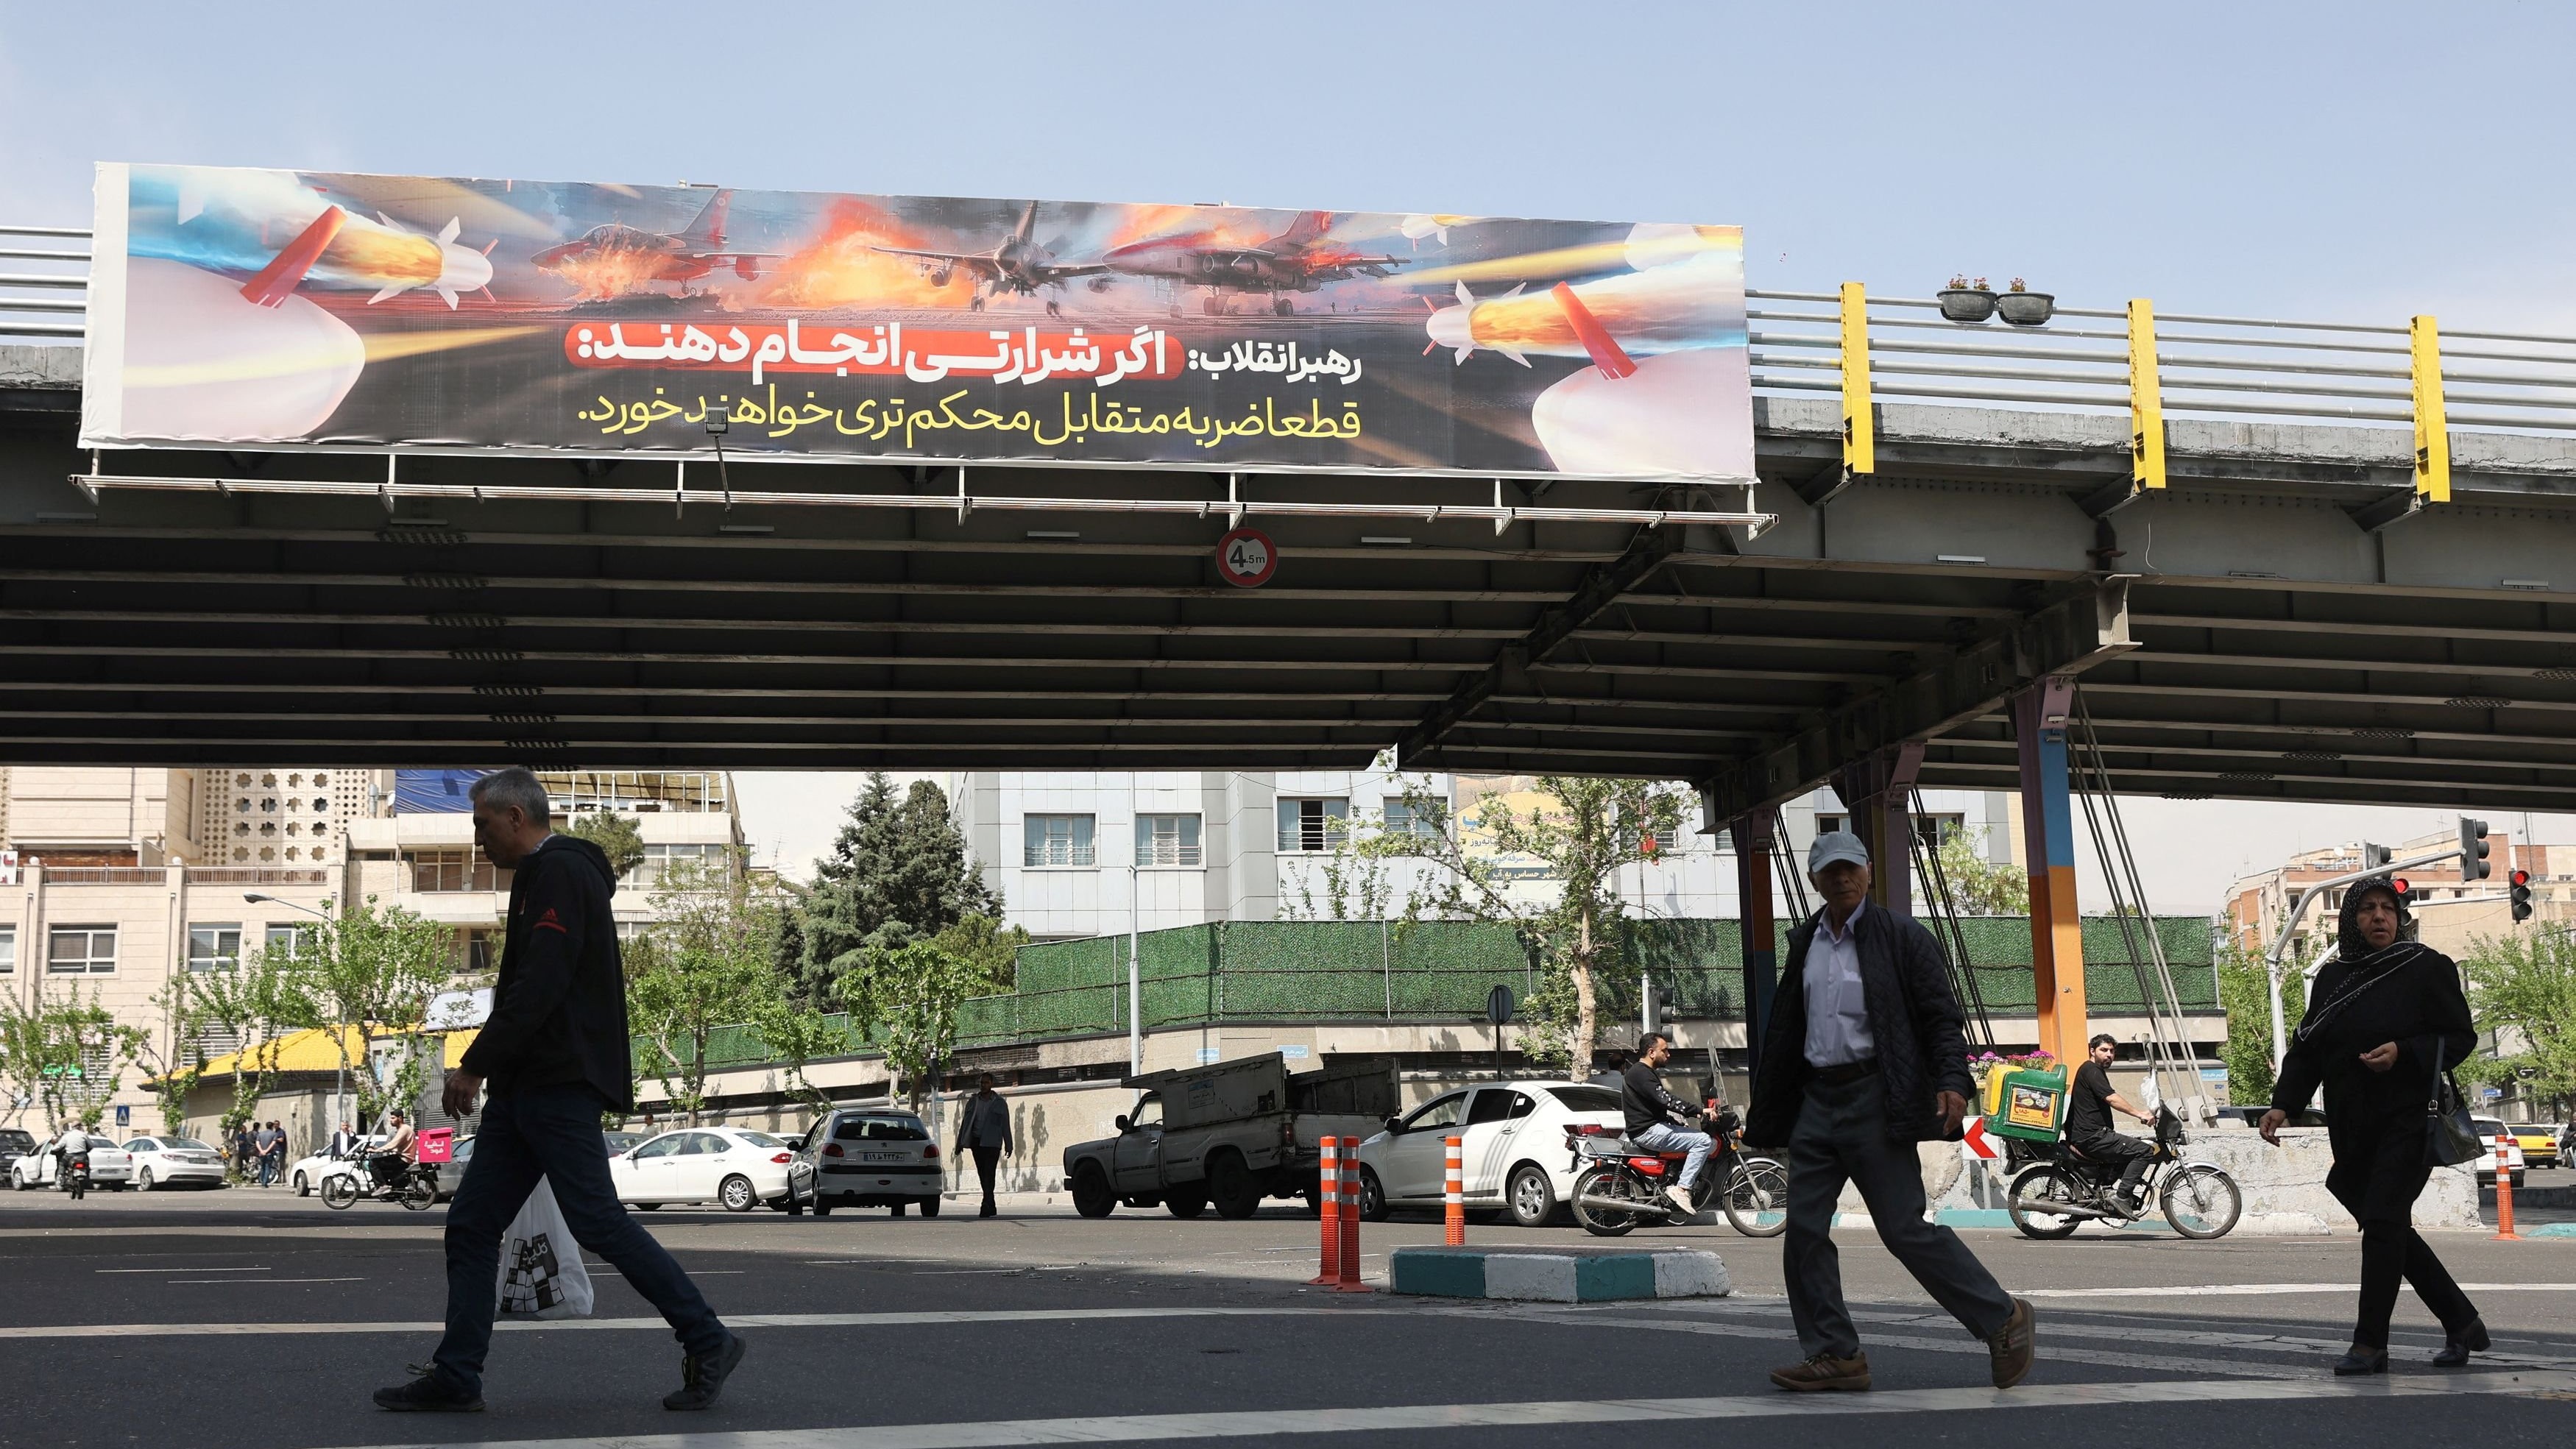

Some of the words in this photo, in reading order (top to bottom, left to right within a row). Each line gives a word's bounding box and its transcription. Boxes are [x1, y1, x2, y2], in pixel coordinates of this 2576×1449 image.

[578, 322, 751, 364] دهند:
[752, 318, 901, 386] انجام
[905, 325, 1101, 386] شرارتی
[1094, 324, 1166, 387] اگر
[578, 387, 683, 436] خورد.
[1033, 392, 1170, 446] متقابل
[1172, 403, 1265, 449] ضربه
[1266, 397, 1361, 439] قطعا
